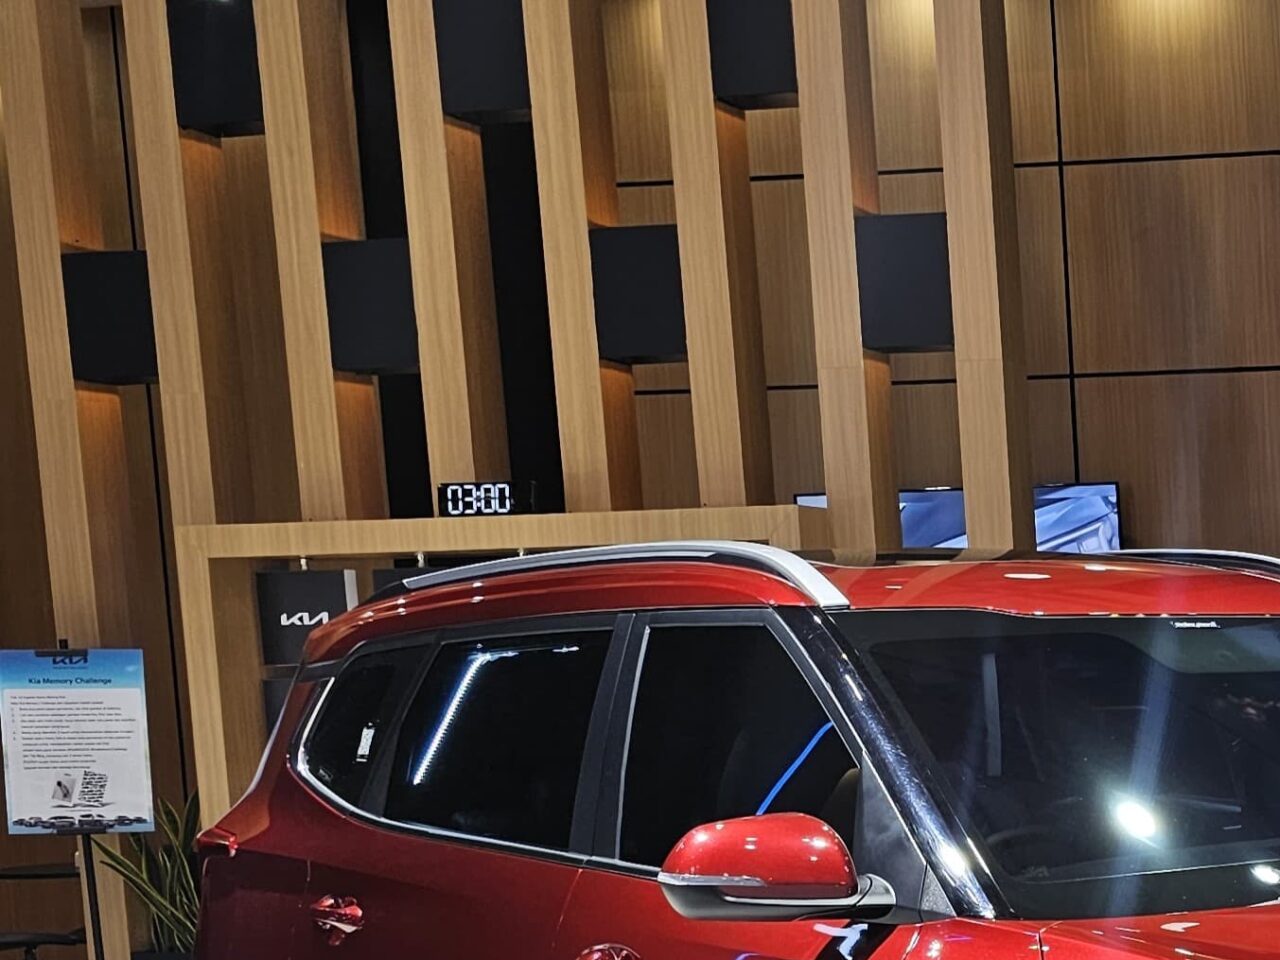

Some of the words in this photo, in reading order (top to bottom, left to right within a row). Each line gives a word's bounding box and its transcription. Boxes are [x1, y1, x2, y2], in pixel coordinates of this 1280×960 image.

[447, 484, 511, 515] 03:00
[280, 611, 329, 626] KIA
[74, 677, 112, 685] Challenge
